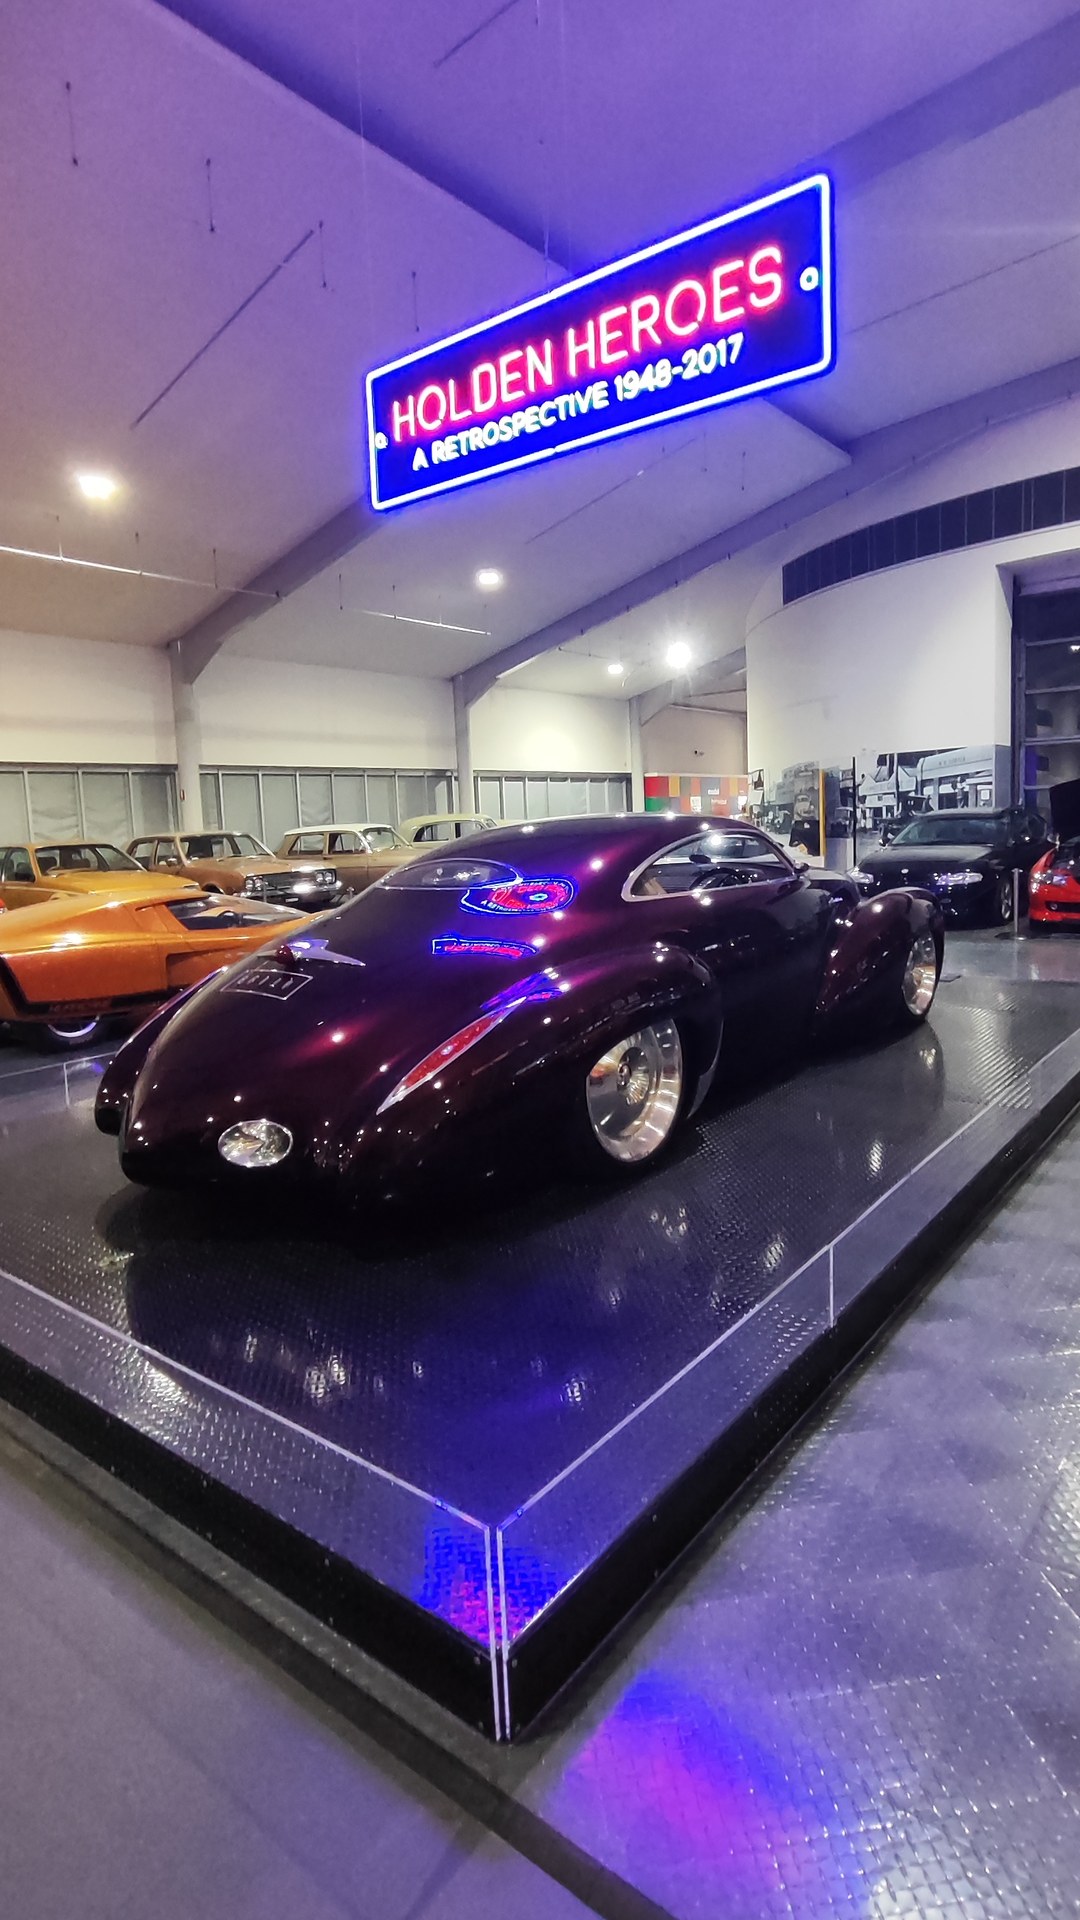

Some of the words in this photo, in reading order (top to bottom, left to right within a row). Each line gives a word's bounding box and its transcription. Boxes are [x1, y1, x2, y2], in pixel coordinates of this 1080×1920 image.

[392, 339, 554, 442] HOLDEN
[567, 246, 783, 377] HEROES
[412, 447, 429, 471] A
[431, 381, 610, 464] RETROSPECTIVE
[613, 332, 744, 402] 1948-2017
